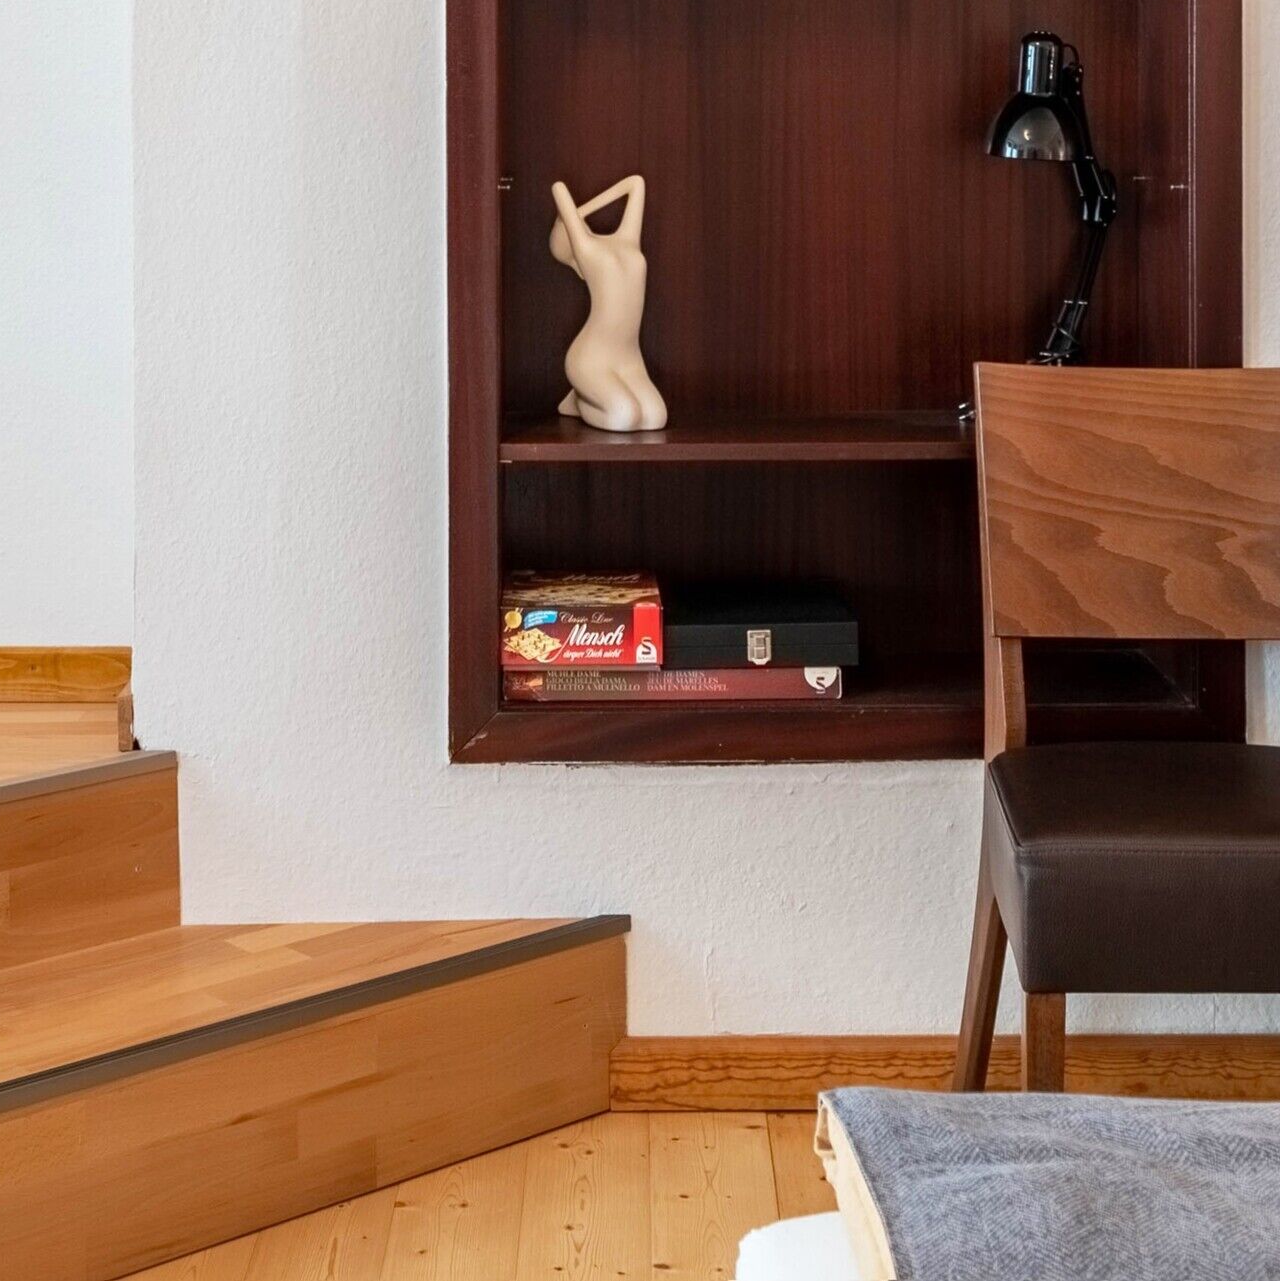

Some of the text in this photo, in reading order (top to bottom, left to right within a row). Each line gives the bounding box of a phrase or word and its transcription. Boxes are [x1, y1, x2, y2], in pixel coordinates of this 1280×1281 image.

[559, 611, 589, 624] Classic
[590, 611, 613, 624] Line
[567, 623, 625, 647] Mensch
[584, 648, 603, 659] Dich
[603, 648, 623, 659] nicht
